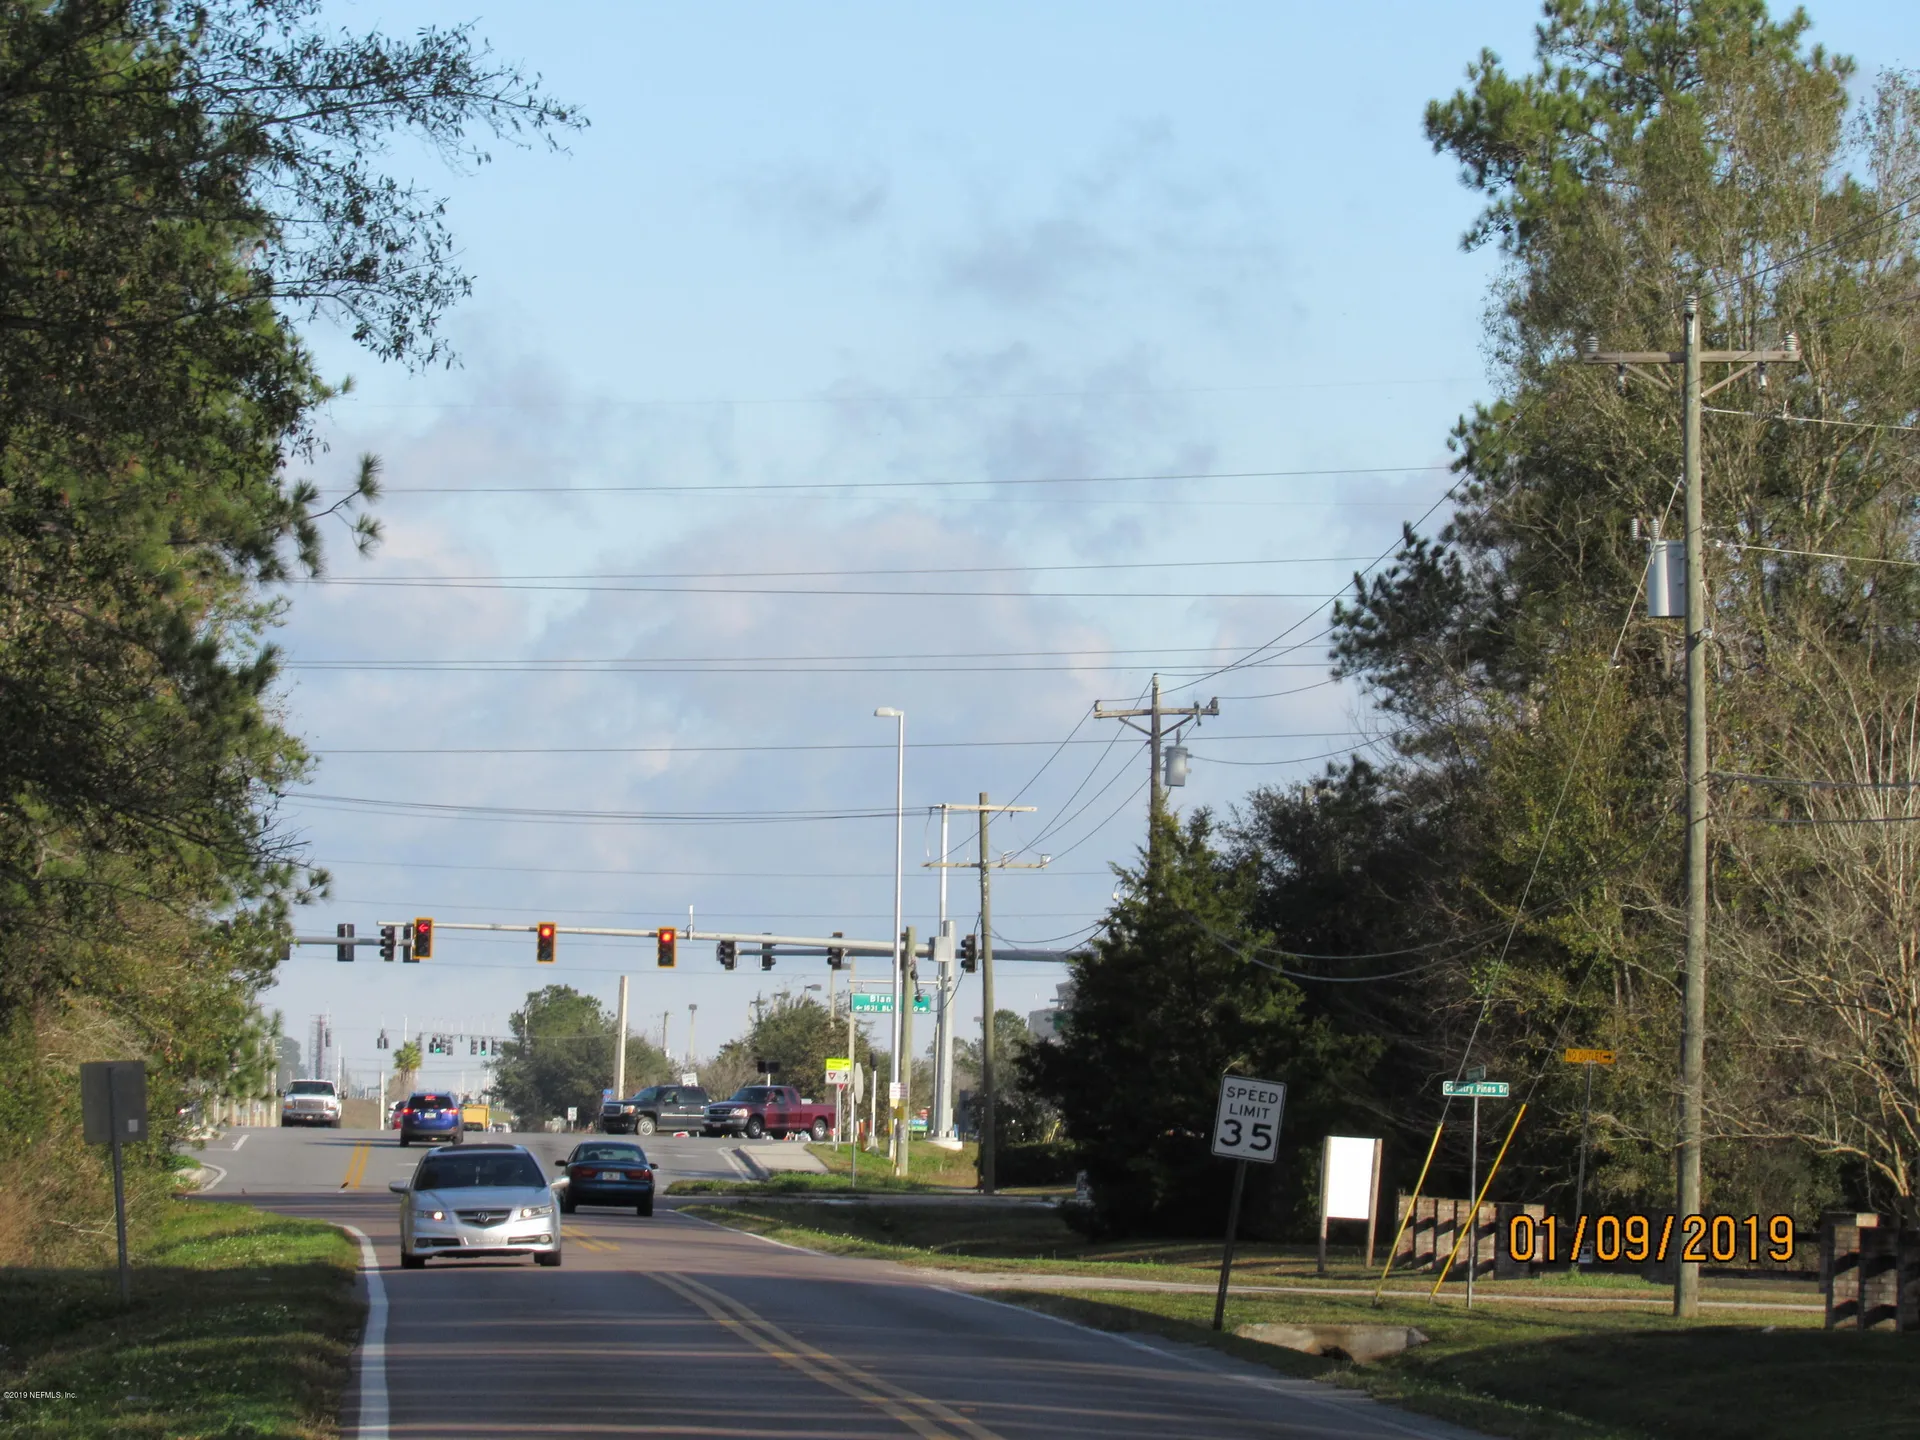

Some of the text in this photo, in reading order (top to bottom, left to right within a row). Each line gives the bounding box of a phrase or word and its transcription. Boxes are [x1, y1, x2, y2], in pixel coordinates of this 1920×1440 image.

[869, 994, 892, 1003] Blan
[1226, 1086, 1279, 1104] SPEED
[1445, 1083, 1508, 1095] Contry Pines Dr
[1229, 1103, 1271, 1120] LIMIT
[1219, 1118, 1272, 1152] 35
